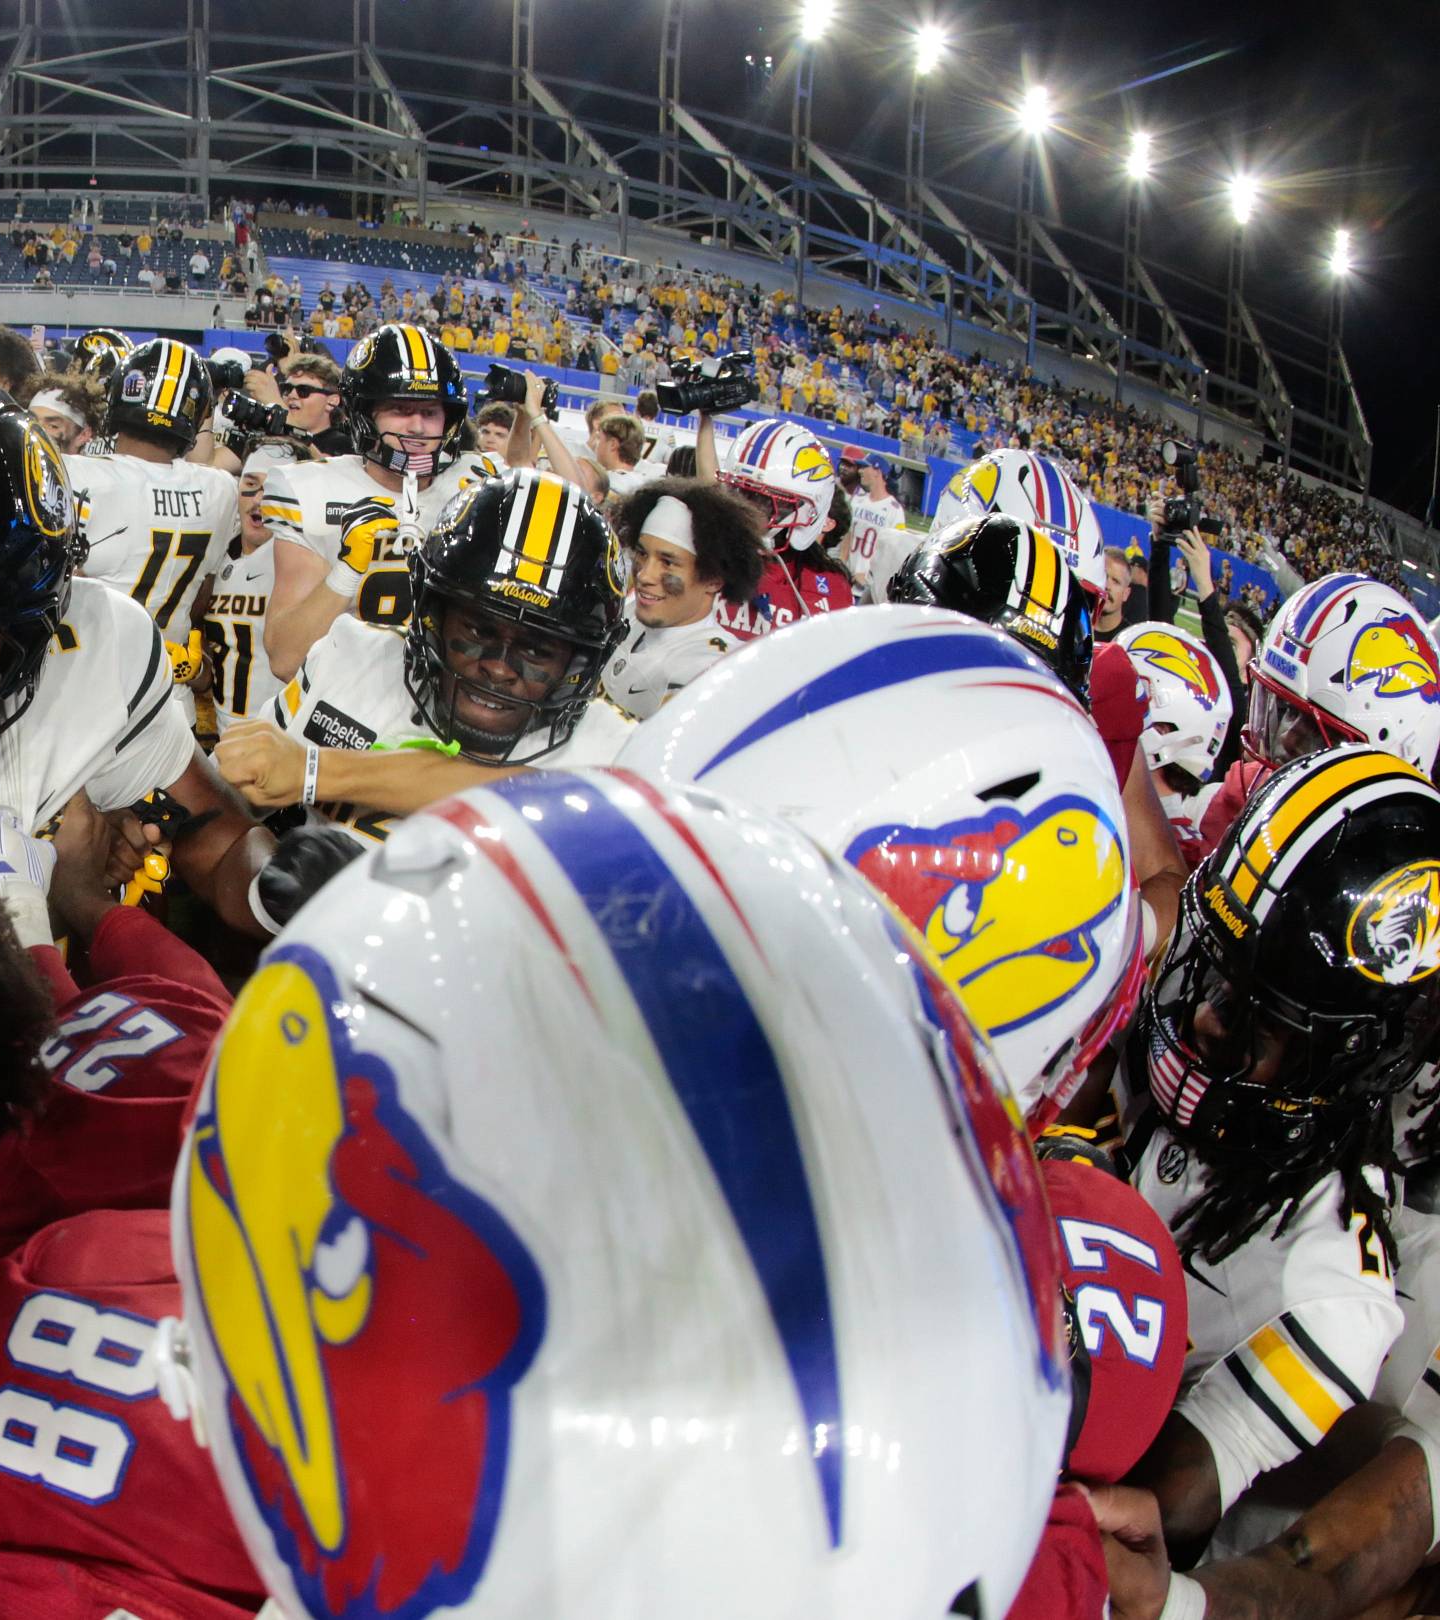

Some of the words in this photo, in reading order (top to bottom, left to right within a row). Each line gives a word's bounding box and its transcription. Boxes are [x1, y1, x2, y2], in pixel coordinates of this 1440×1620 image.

[152, 487, 203, 518] HUFF
[131, 528, 214, 632] 17
[491, 577, 552, 609] Missouri
[208, 594, 267, 617] ZZOU
[712, 591, 806, 635] KANS
[1264, 647, 1299, 682] KANSAS
[1204, 884, 1249, 939] Missouri
[38, 991, 186, 1093] 22
[1059, 1216, 1165, 1370] 27
